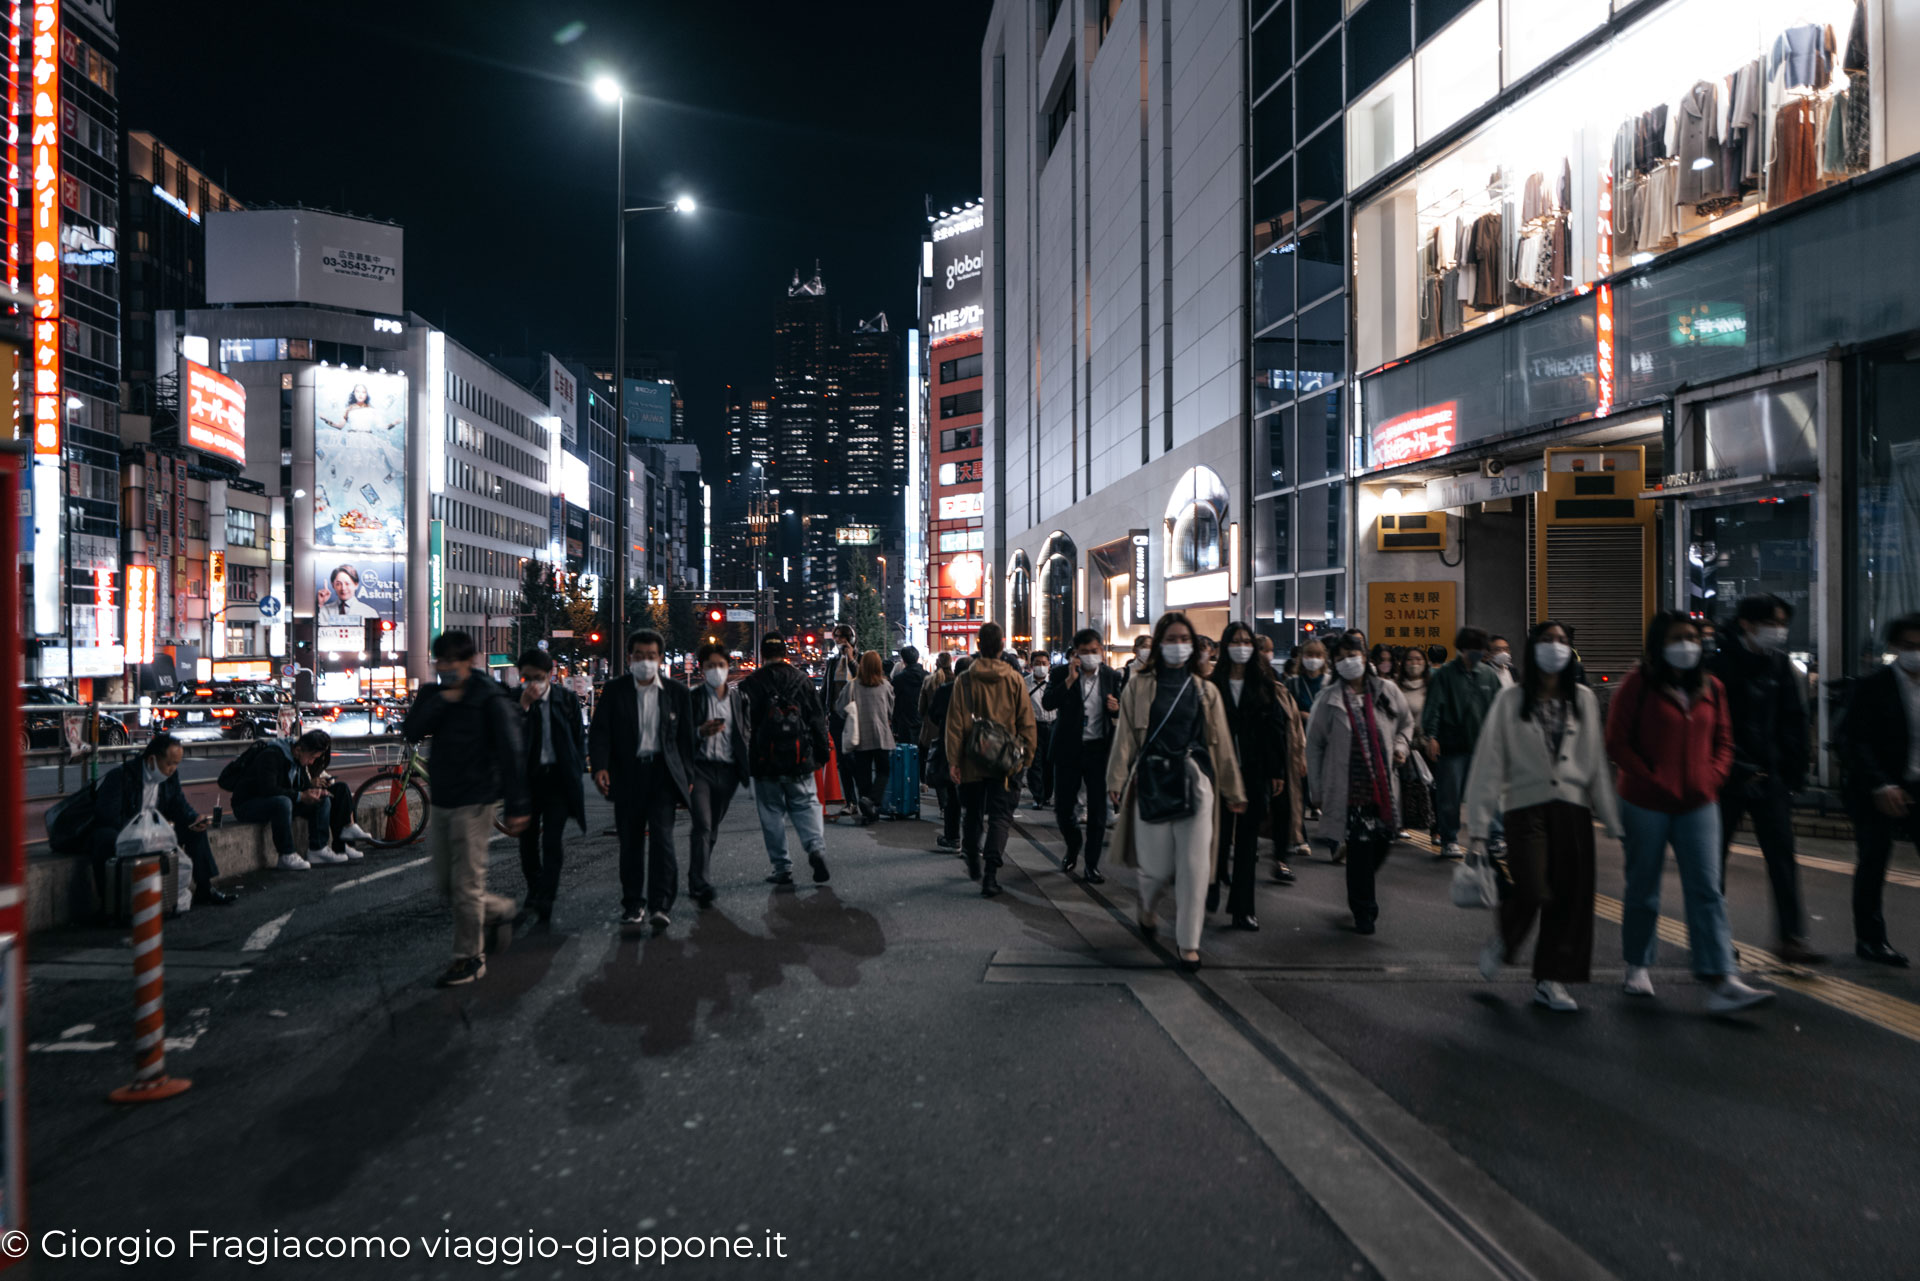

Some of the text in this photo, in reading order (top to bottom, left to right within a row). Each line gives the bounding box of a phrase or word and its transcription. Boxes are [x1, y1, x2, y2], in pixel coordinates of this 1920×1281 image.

[323, 257, 395, 276] 03-3543-7771
[946, 250, 983, 290] global
[1136, 547, 1145, 619] UNITED ARROWS
[357, 585, 403, 602] Asking!
[1384, 592, 1440, 603] 高さ制限
[1384, 626, 1441, 638] 重量制限
